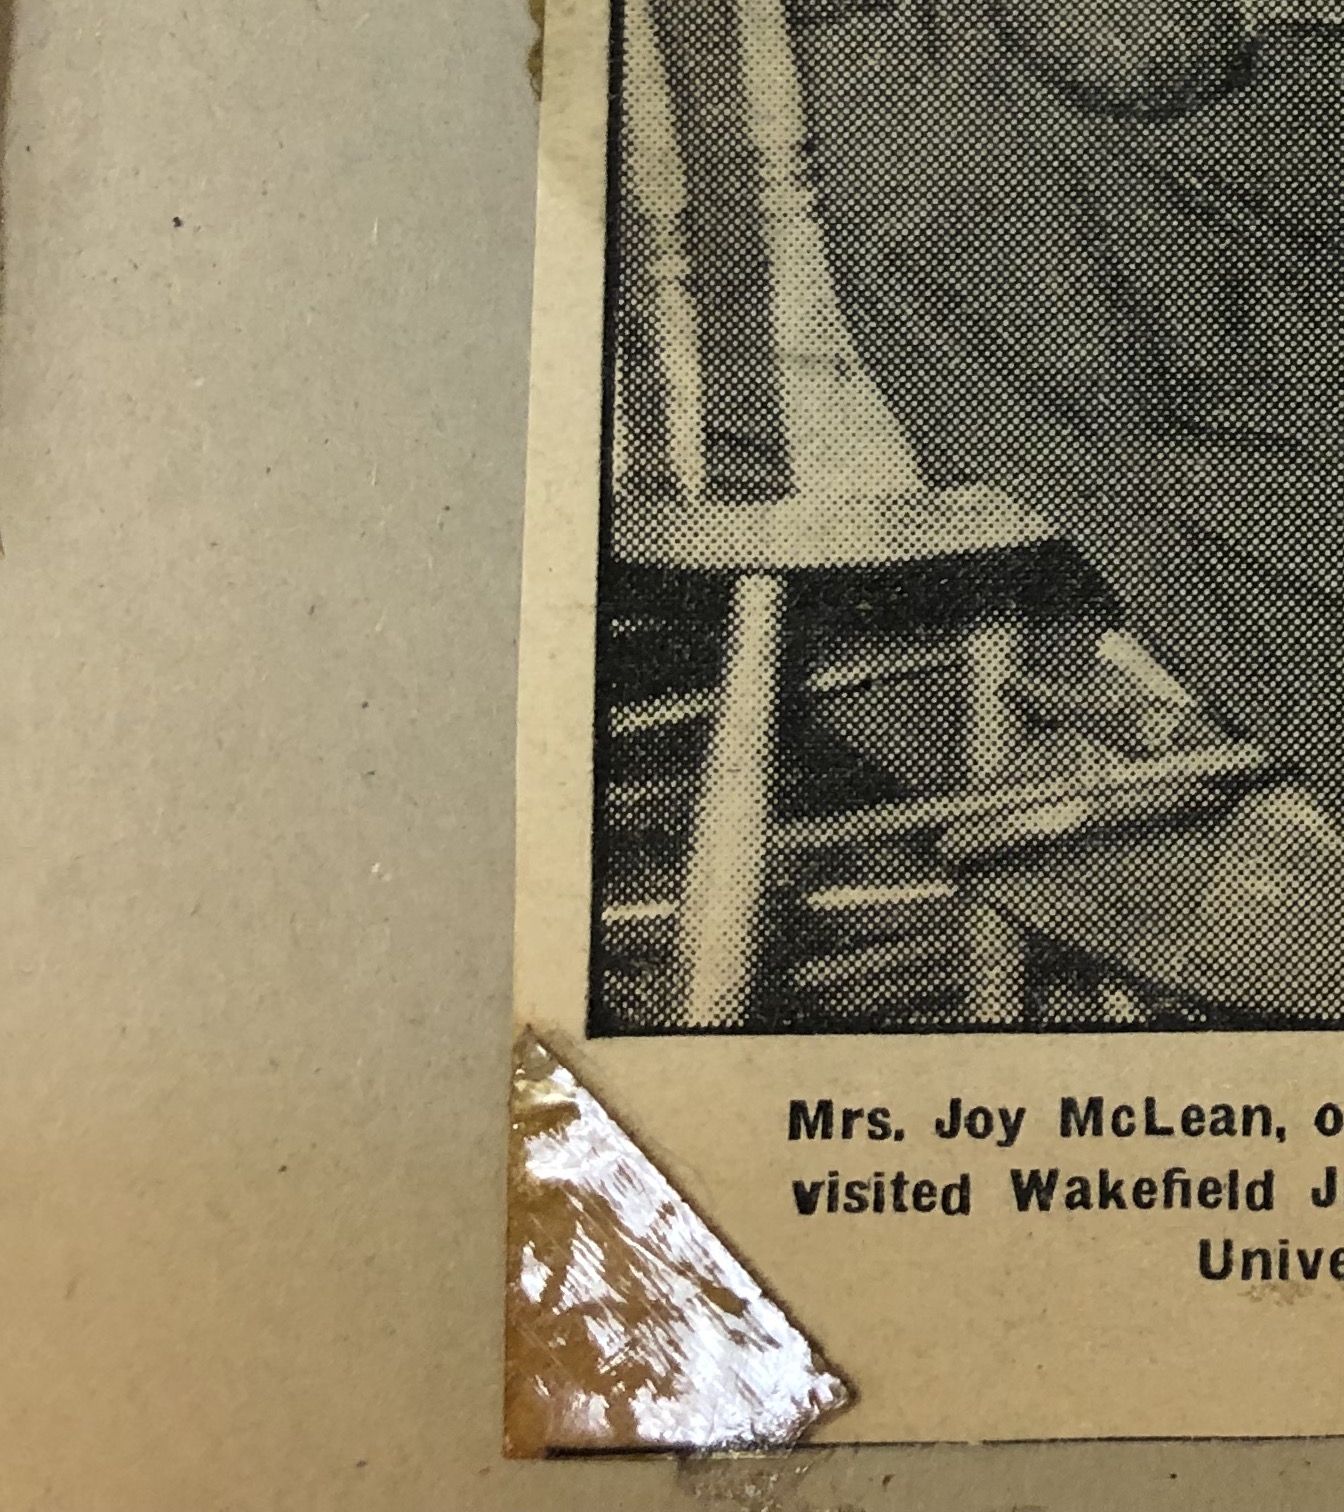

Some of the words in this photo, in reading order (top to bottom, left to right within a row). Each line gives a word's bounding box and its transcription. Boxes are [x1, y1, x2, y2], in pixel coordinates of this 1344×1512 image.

[787, 1098, 905, 1142] Mrs.
[934, 1097, 1027, 1148] Joy
[1059, 1095, 1287, 1144] McLean,
[791, 1169, 971, 1217] visited
[1009, 1166, 1276, 1213] Wakefield
